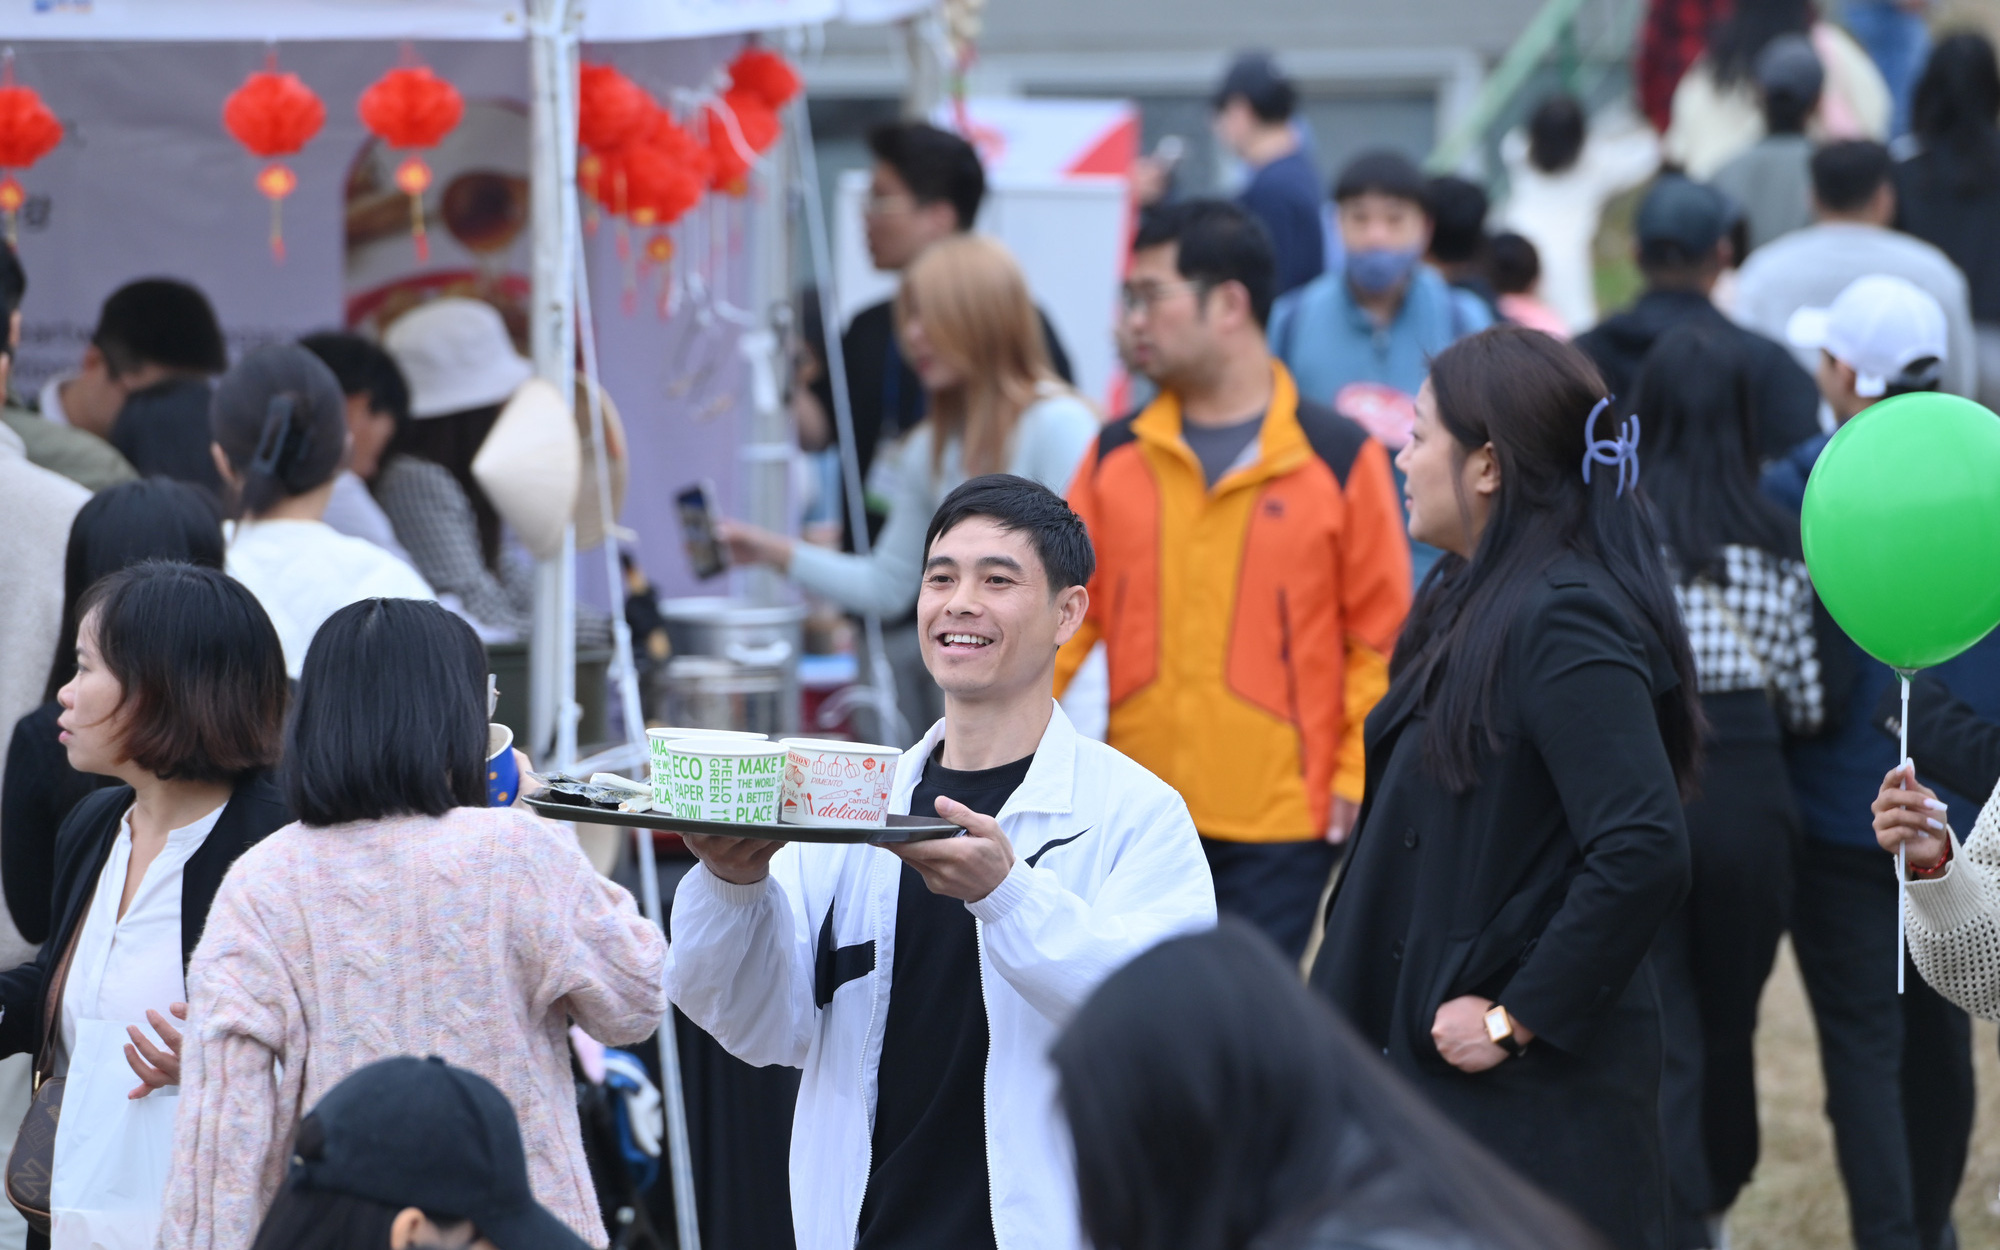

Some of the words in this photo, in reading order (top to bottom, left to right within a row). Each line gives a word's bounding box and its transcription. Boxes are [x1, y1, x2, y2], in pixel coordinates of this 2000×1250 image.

[652, 739, 669, 757] MA
[672, 754, 703, 781] ECO
[738, 757, 777, 775] MAKE
[787, 752, 809, 767] ONION
[709, 758, 720, 803] GREEN
[721, 758, 733, 804] HELLO
[737, 779, 752, 789] THE
[755, 777, 775, 788] WORLD
[811, 777, 842, 788] PIMENTO
[655, 787, 672, 804] PLA
[675, 782, 704, 802] PAPER
[737, 792, 745, 804] A
[747, 791, 773, 804] BETTER
[736, 805, 773, 823] PLACE
[818, 802, 880, 821] delicious
